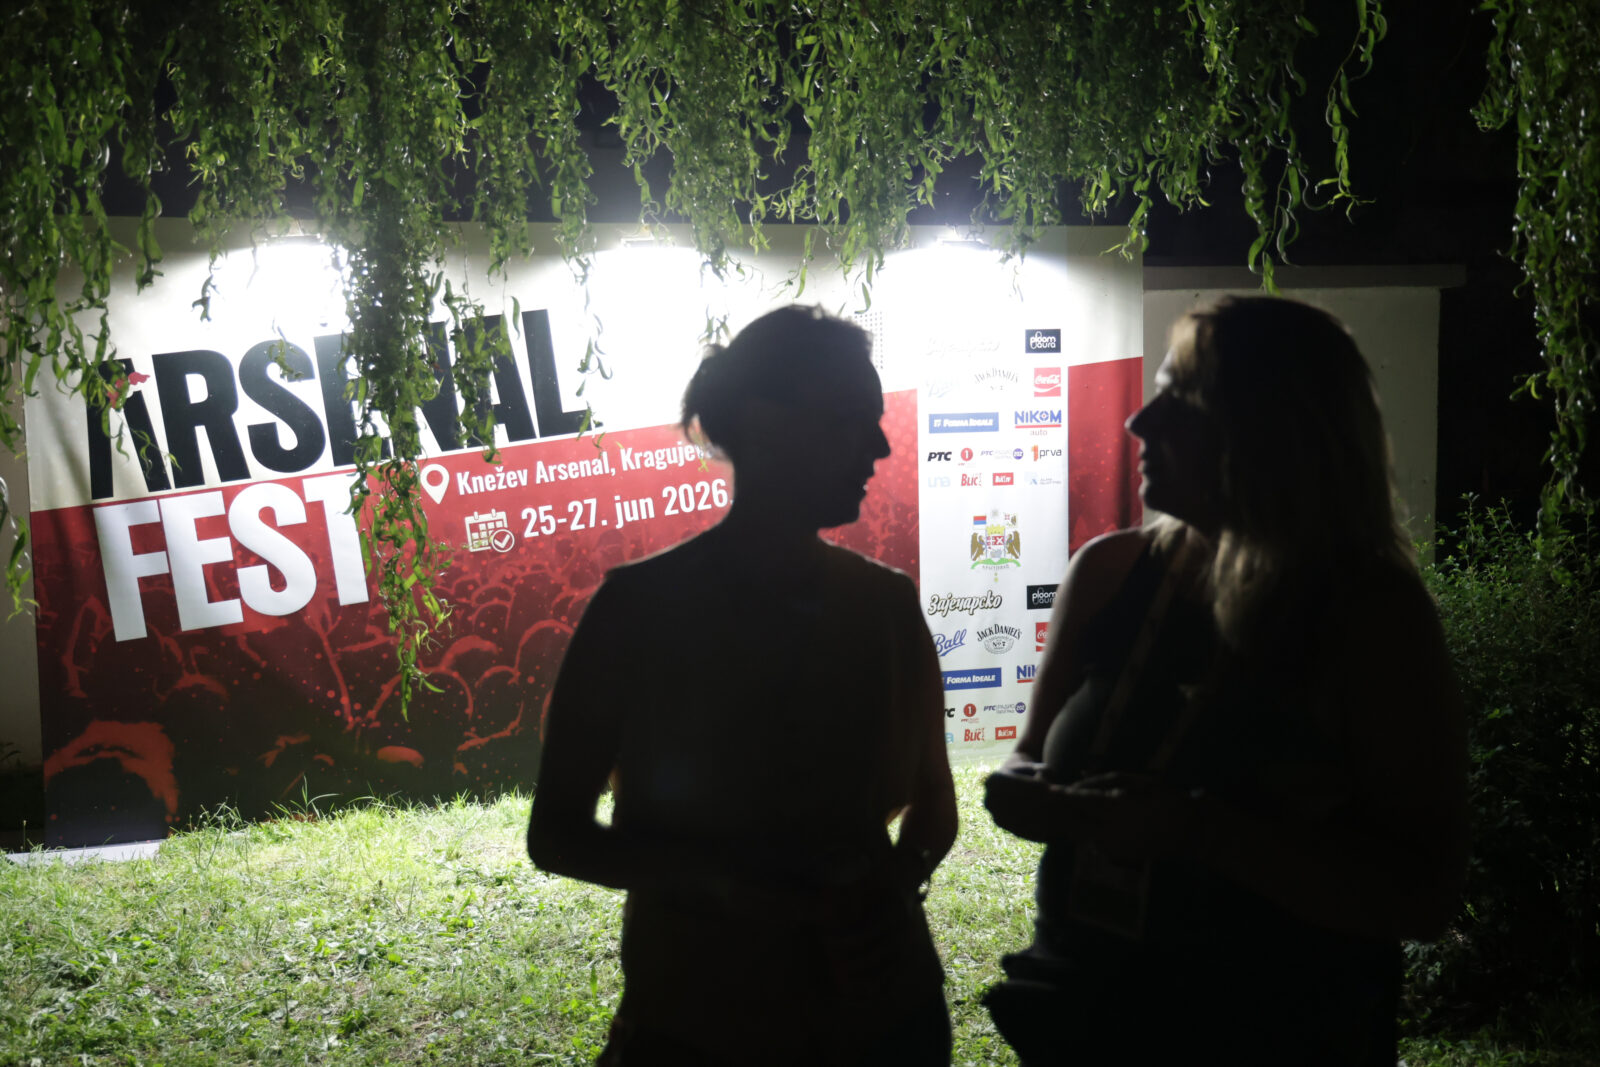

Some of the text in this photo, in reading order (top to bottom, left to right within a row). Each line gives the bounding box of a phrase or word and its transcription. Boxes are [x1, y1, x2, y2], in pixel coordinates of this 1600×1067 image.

[456, 467, 528, 495] Knežev
[535, 452, 616, 484] Arsenal,
[521, 498, 608, 538] 25-27.
[614, 495, 655, 529] jun
[94, 473, 369, 642] FEST
[932, 628, 967, 655] Ball
[976, 626, 994, 642] JACK
[946, 675, 996, 685] FORMA IDEALE
